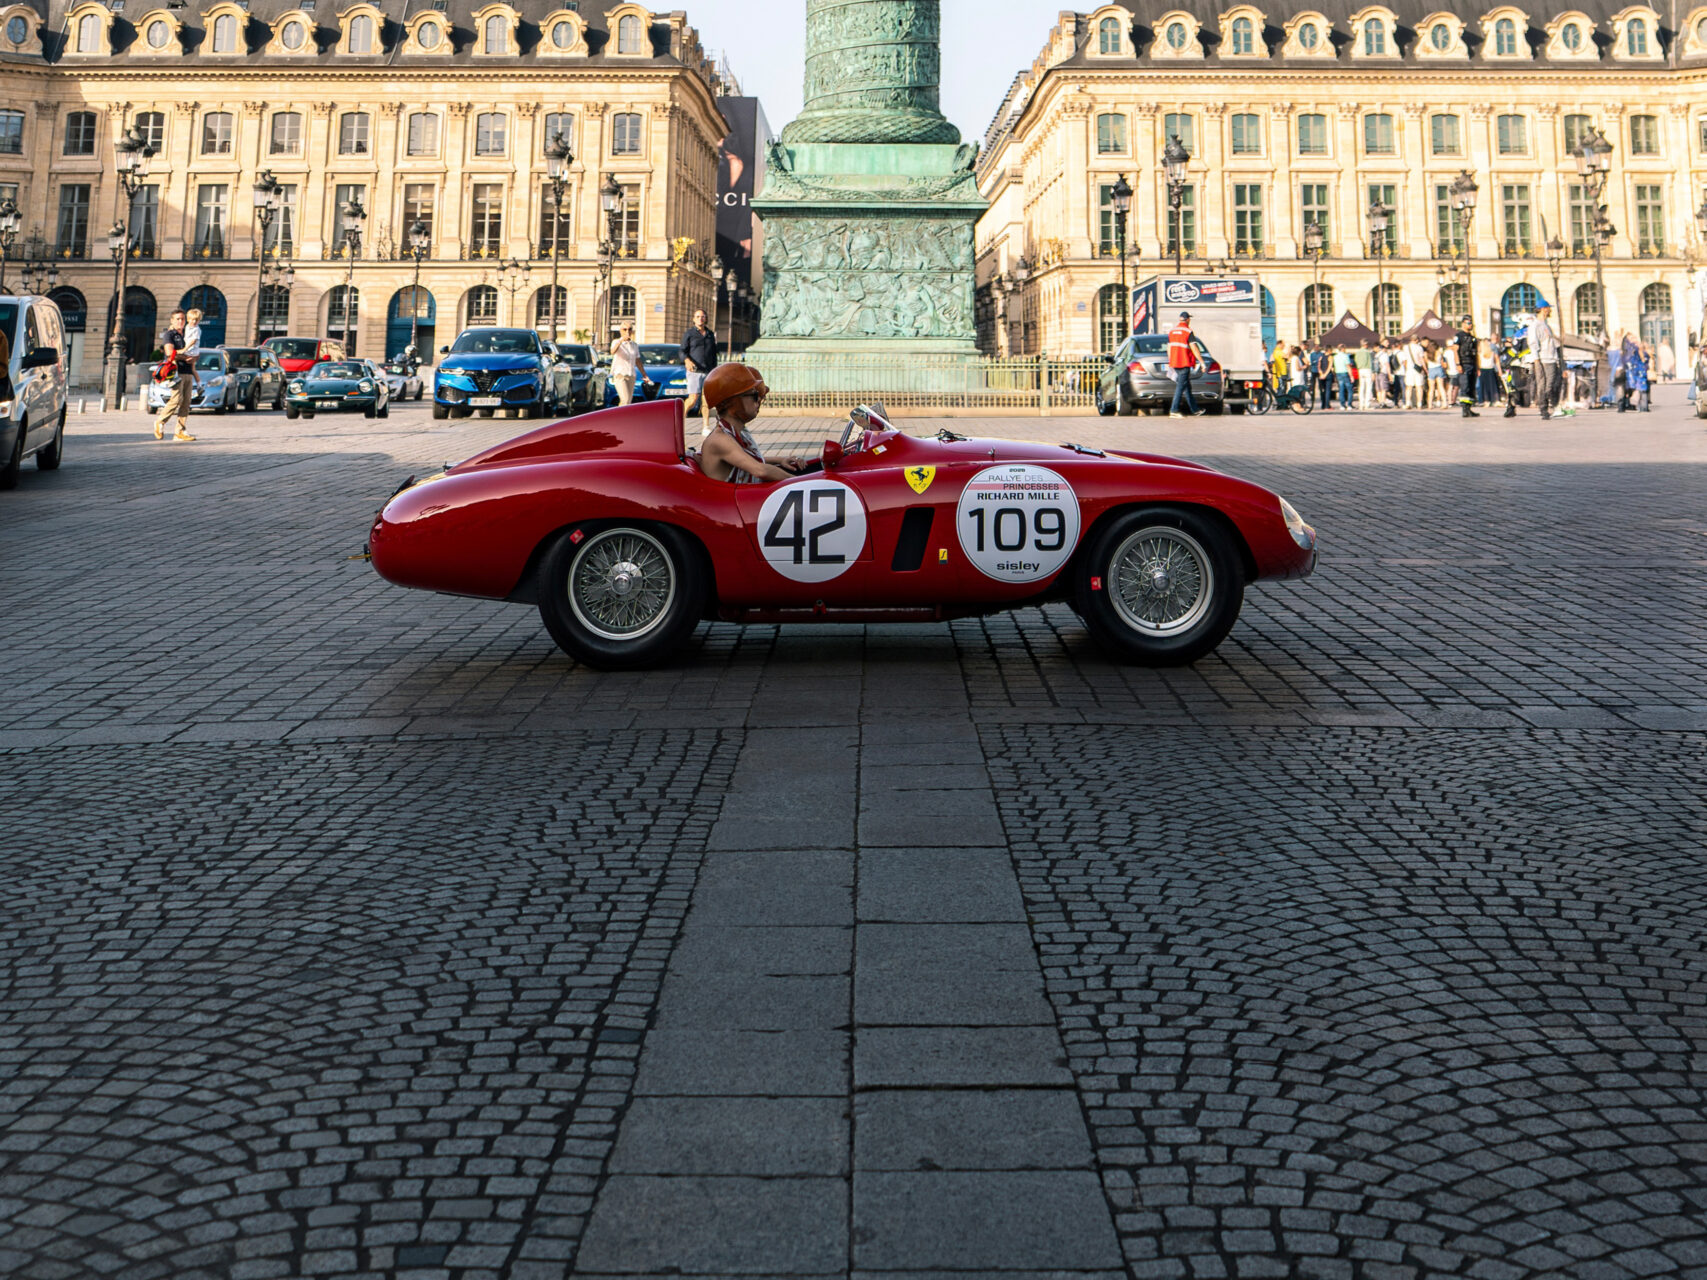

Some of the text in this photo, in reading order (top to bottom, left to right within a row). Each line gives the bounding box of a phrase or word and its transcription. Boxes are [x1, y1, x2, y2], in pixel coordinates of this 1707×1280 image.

[988, 474, 1044, 482] RALLYE DES
[1003, 483, 1060, 491] PRINCESSES
[977, 492, 1060, 501] RICHARD MILLE
[763, 488, 846, 565] 42
[968, 507, 1066, 552] 109
[996, 560, 1040, 572] sisley
